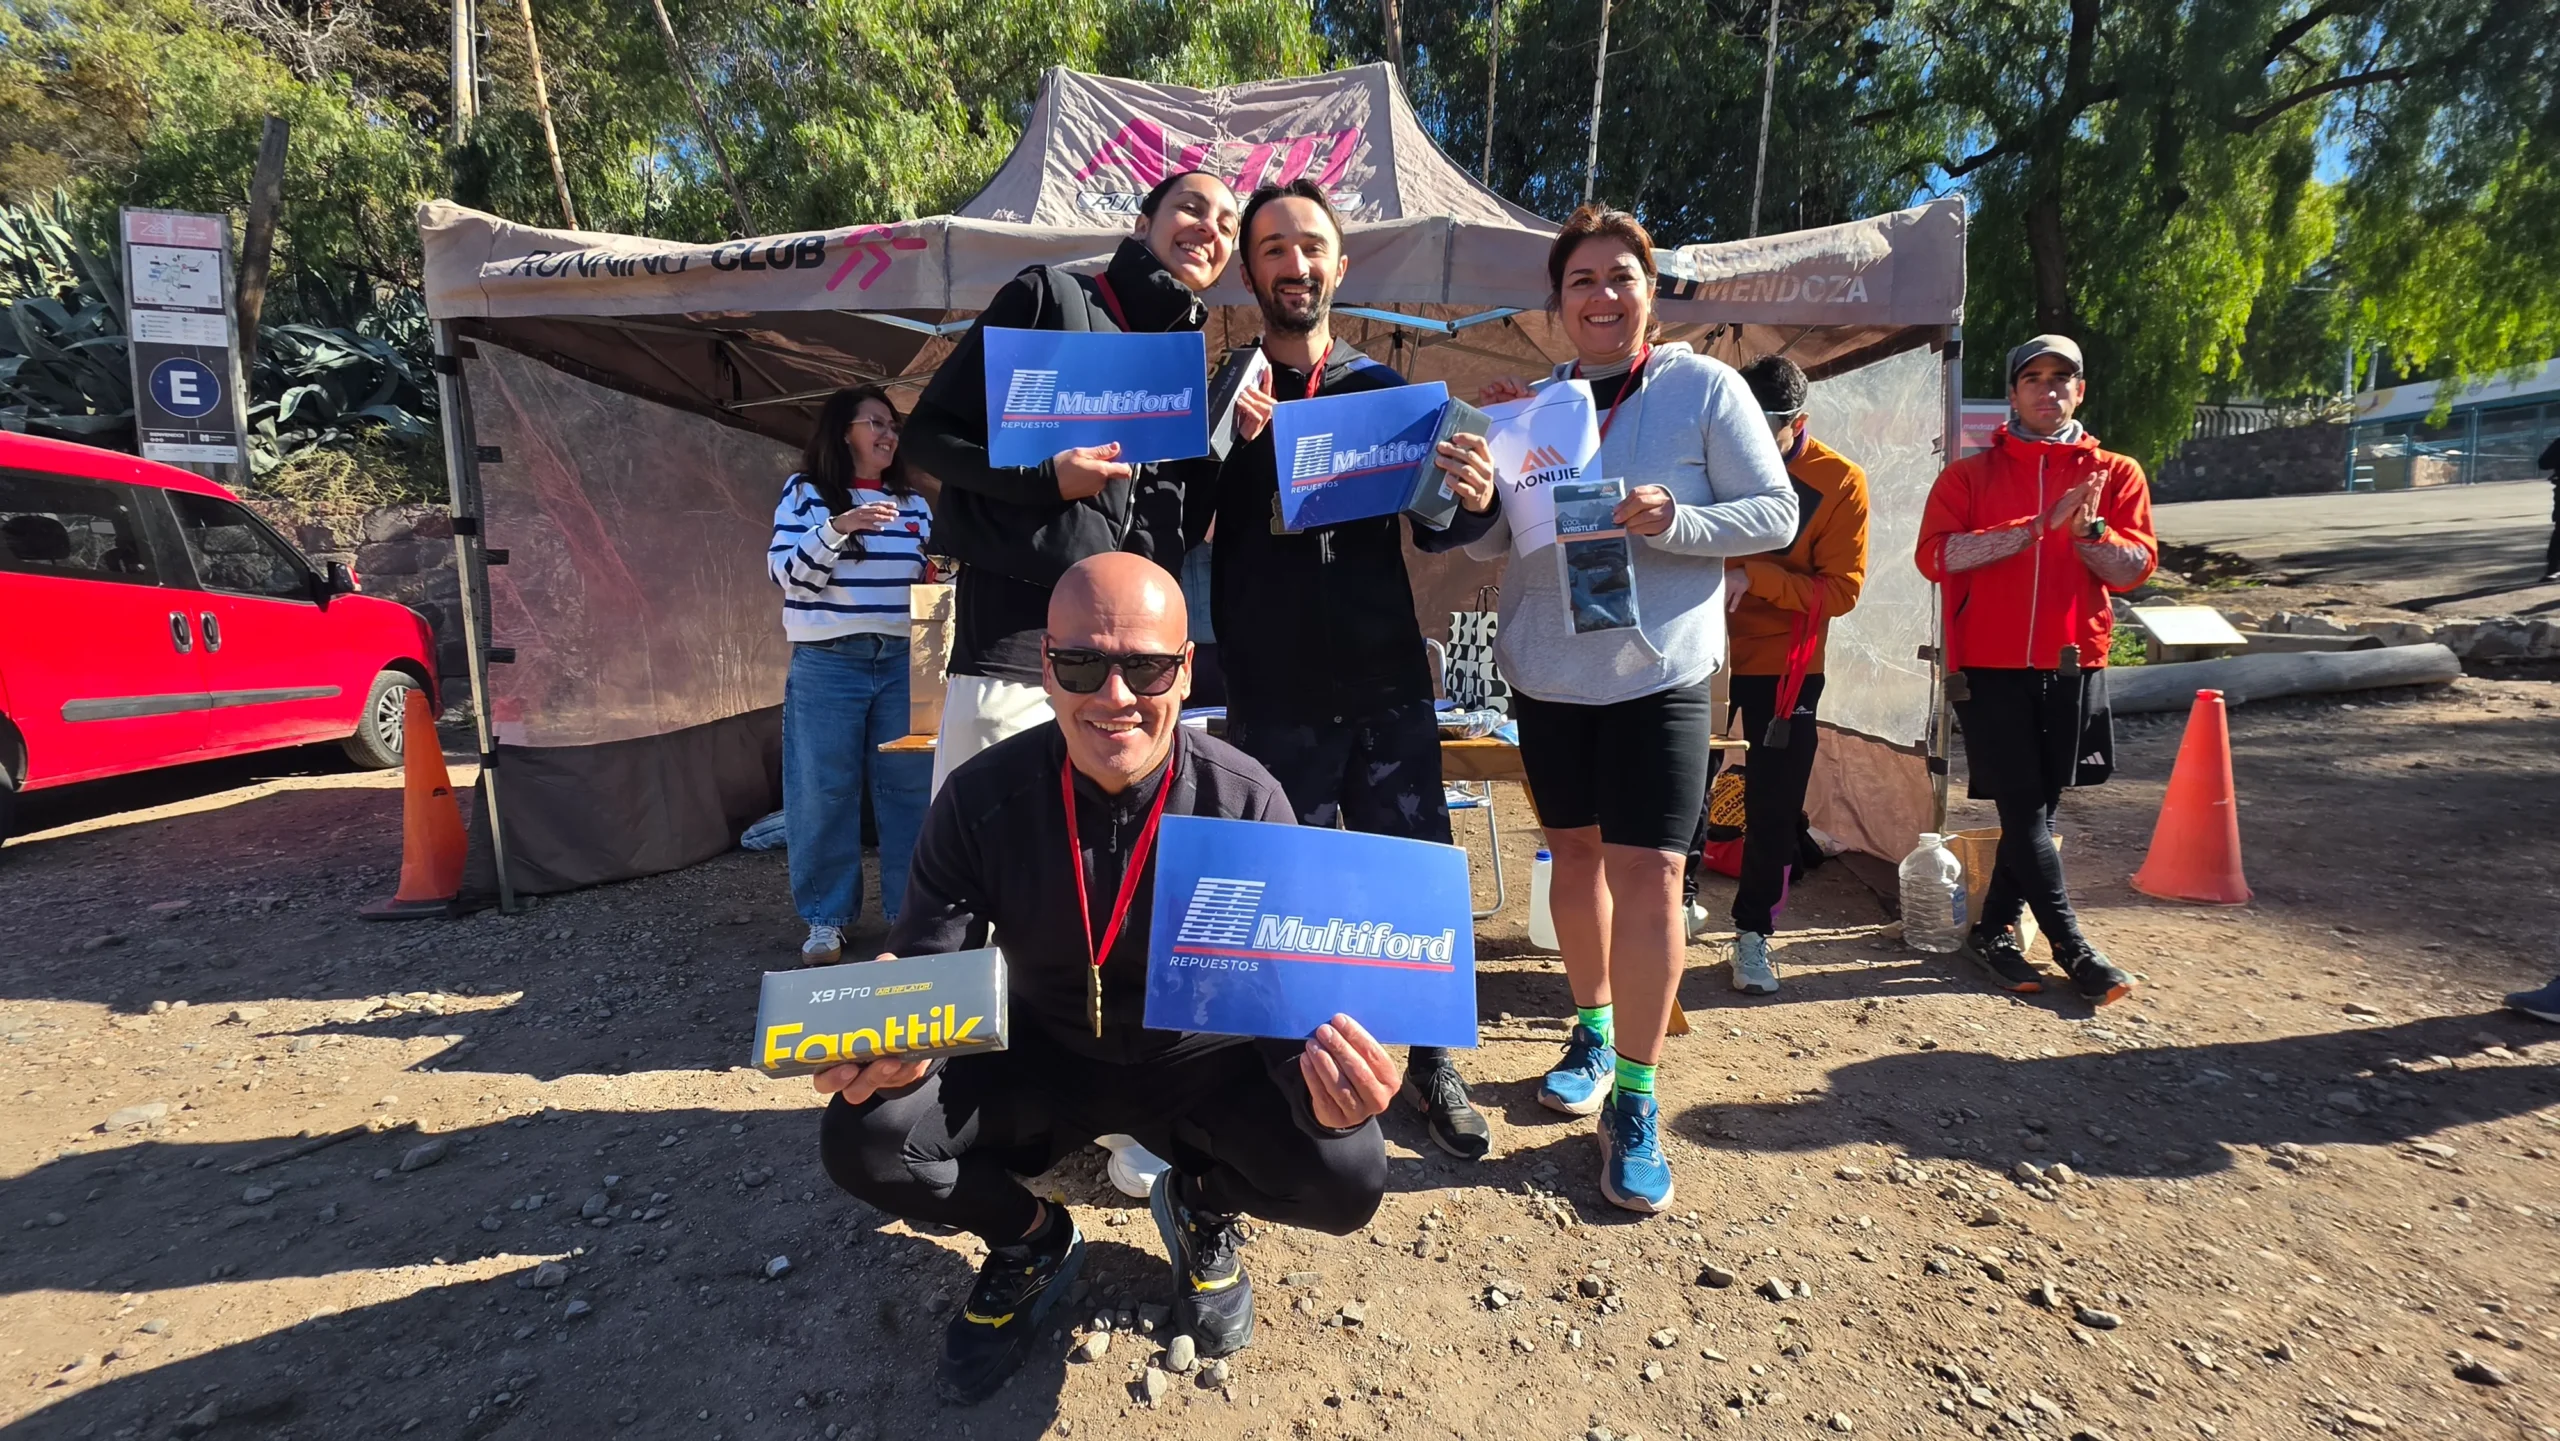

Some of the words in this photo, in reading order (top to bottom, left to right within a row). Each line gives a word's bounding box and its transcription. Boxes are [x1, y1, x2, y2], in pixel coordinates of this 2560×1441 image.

[710, 234, 827, 272] CLUB
[1697, 273, 1869, 303] MENDOZA
[169, 370, 201, 406] E
[1053, 387, 1193, 415] Multiford
[1001, 421, 1060, 429] REPUESTOS
[1332, 440, 1431, 474] Multifor
[1291, 481, 1339, 494] REPUESTOS
[1514, 467, 1580, 493] AONIJIE
[1562, 524, 1599, 533] WRISTLET
[1251, 913, 1456, 964] Multiford
[1168, 955, 1260, 972] REPUESTOS
[809, 989, 836, 1004] X9
[838, 986, 871, 1000] Pro
[877, 987, 892, 995] AIR
[893, 982, 931, 993] INFLATOR
[763, 1003, 988, 1070] Fanttik
